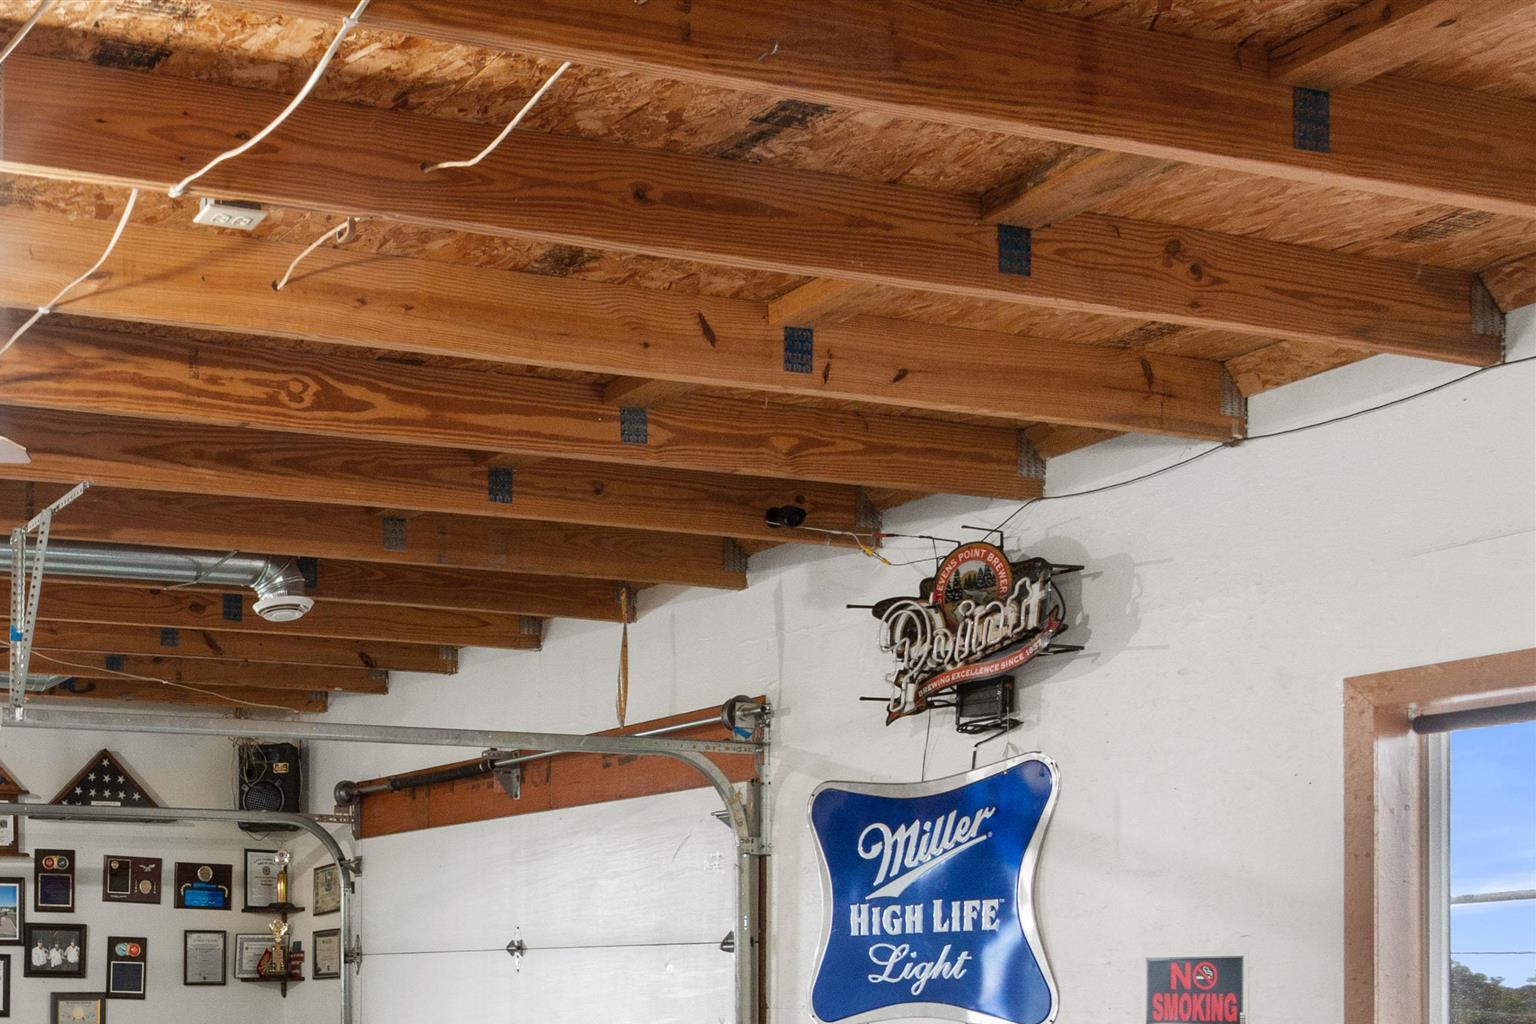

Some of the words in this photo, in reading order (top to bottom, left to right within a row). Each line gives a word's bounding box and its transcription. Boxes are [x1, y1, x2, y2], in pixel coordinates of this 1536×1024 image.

[958, 548, 986, 562] POINT
[918, 674, 951, 697] BREWING
[951, 665, 1000, 680] EXCELLENCE
[1000, 655, 1026, 670] SINCE
[858, 806, 996, 890] Miller
[850, 904, 924, 936] HIGH
[932, 899, 1001, 933] LIFE
[868, 943, 972, 995] Light
[1170, 960, 1218, 990] NO
[1151, 993, 1238, 1023] SMOKING
